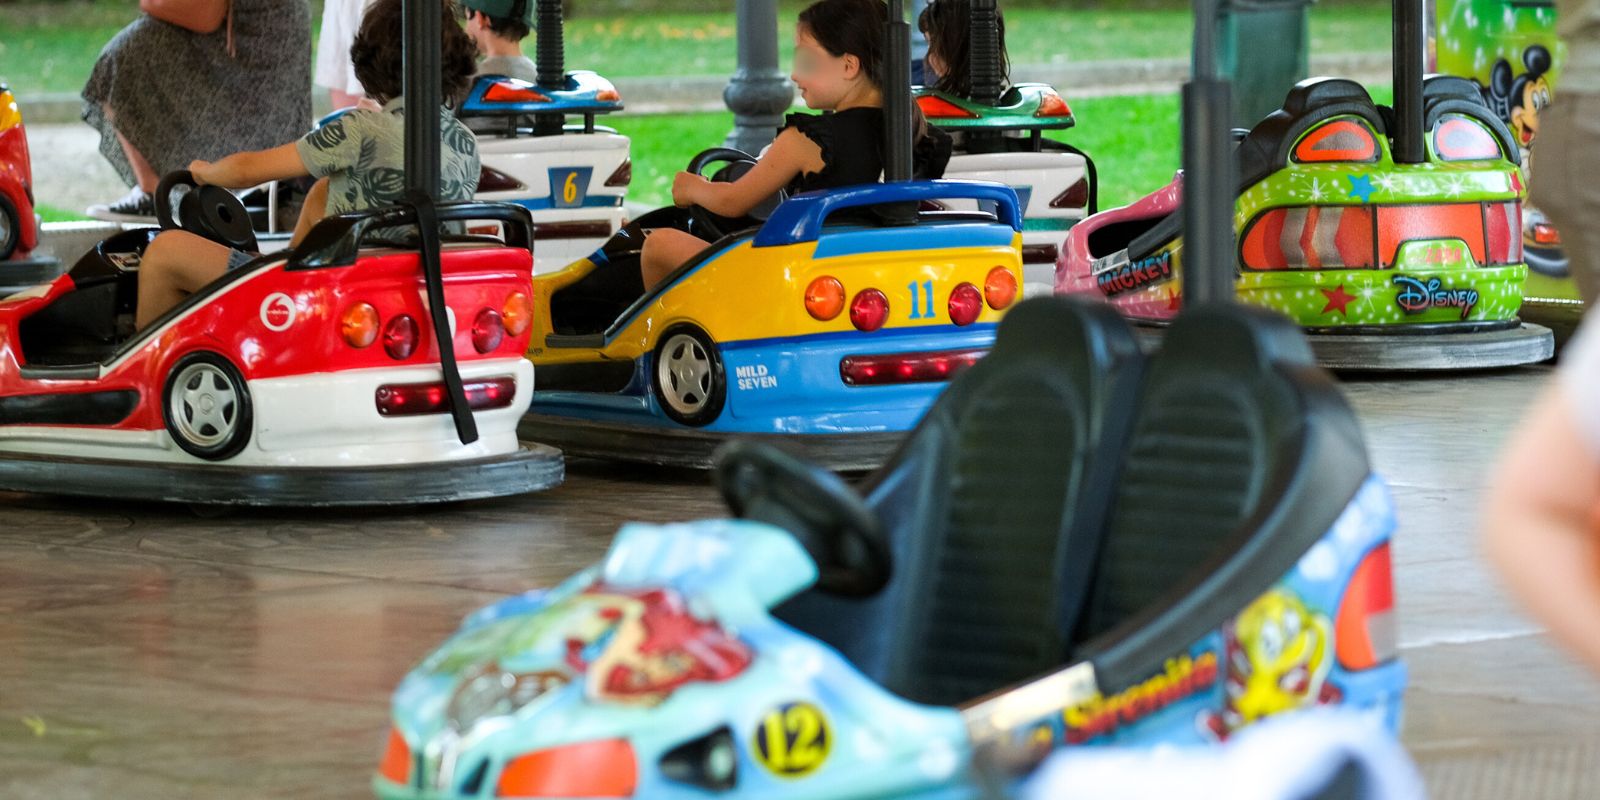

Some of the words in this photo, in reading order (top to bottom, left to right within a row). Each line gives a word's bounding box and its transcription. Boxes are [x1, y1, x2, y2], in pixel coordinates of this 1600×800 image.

[563, 171, 578, 204] 6
[1098, 250, 1170, 295] MICKEY
[907, 280, 936, 320] 11
[735, 364, 768, 378] MILD
[738, 375, 778, 391] SEVEN
[765, 702, 826, 771] 12
